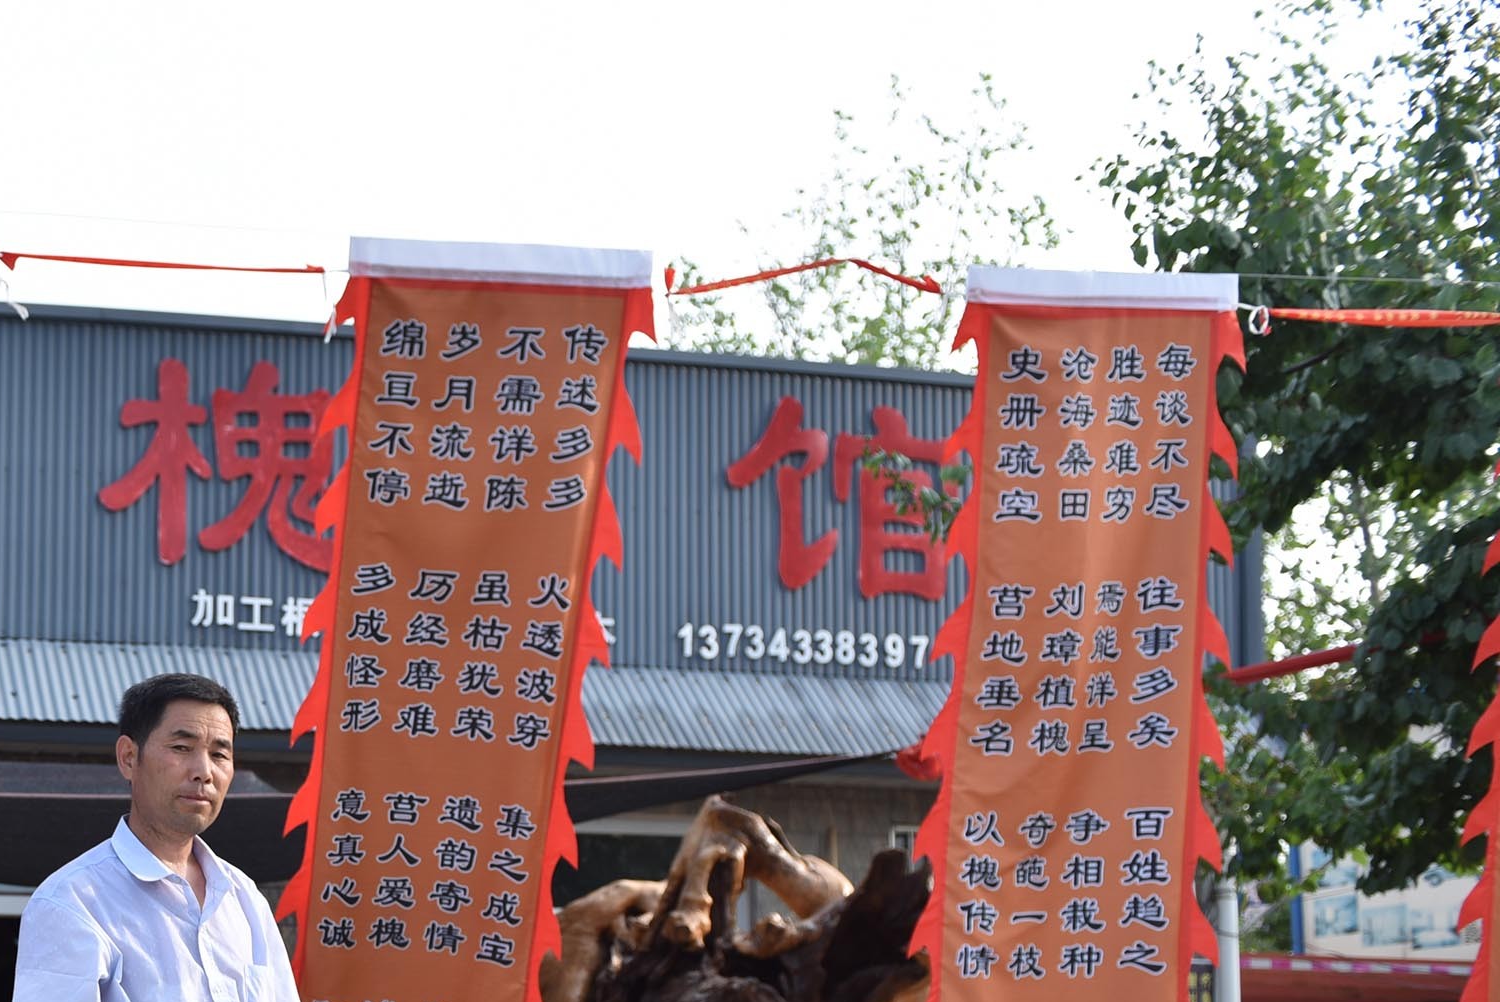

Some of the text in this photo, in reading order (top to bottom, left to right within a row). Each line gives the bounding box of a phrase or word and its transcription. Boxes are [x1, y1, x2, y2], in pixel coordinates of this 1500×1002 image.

[98, 358, 338, 574] 槐
[727, 396, 960, 602] 馆
[363, 318, 428, 507] 绵亘不停
[422, 321, 482, 511] 岁月流逝
[484, 325, 547, 513] 不需详陈
[541, 323, 609, 511] 传述多多
[993, 344, 1049, 524] 史册疏空
[1057, 347, 1098, 522] 沧海桑田
[1102, 344, 1147, 522] 胜迹难穷
[1144, 343, 1196, 519] 每谈不尽
[339, 563, 396, 735] 多成怪形
[393, 569, 459, 738] 历经磨难
[450, 572, 511, 742] 虽枯犹荣
[508, 575, 572, 751] 火透波穿
[677, 622, 930, 669] 13734338397
[970, 583, 1036, 756] 莒地垂名
[1030, 583, 1086, 754] 刘璋植槐
[1076, 581, 1126, 754] 焉能详呈
[1128, 576, 1184, 749] 往事多矣
[317, 787, 370, 951] 意真心诚
[367, 791, 429, 951] 莒人爱槐
[424, 795, 485, 956] 遗韵寄情
[473, 802, 537, 968] 集之成宝
[958, 810, 1004, 979] 以槐传情
[1009, 813, 1056, 979] 奇葩一枝
[1058, 808, 1110, 978] 争相栽种
[1117, 807, 1173, 976] 百姓趋之
